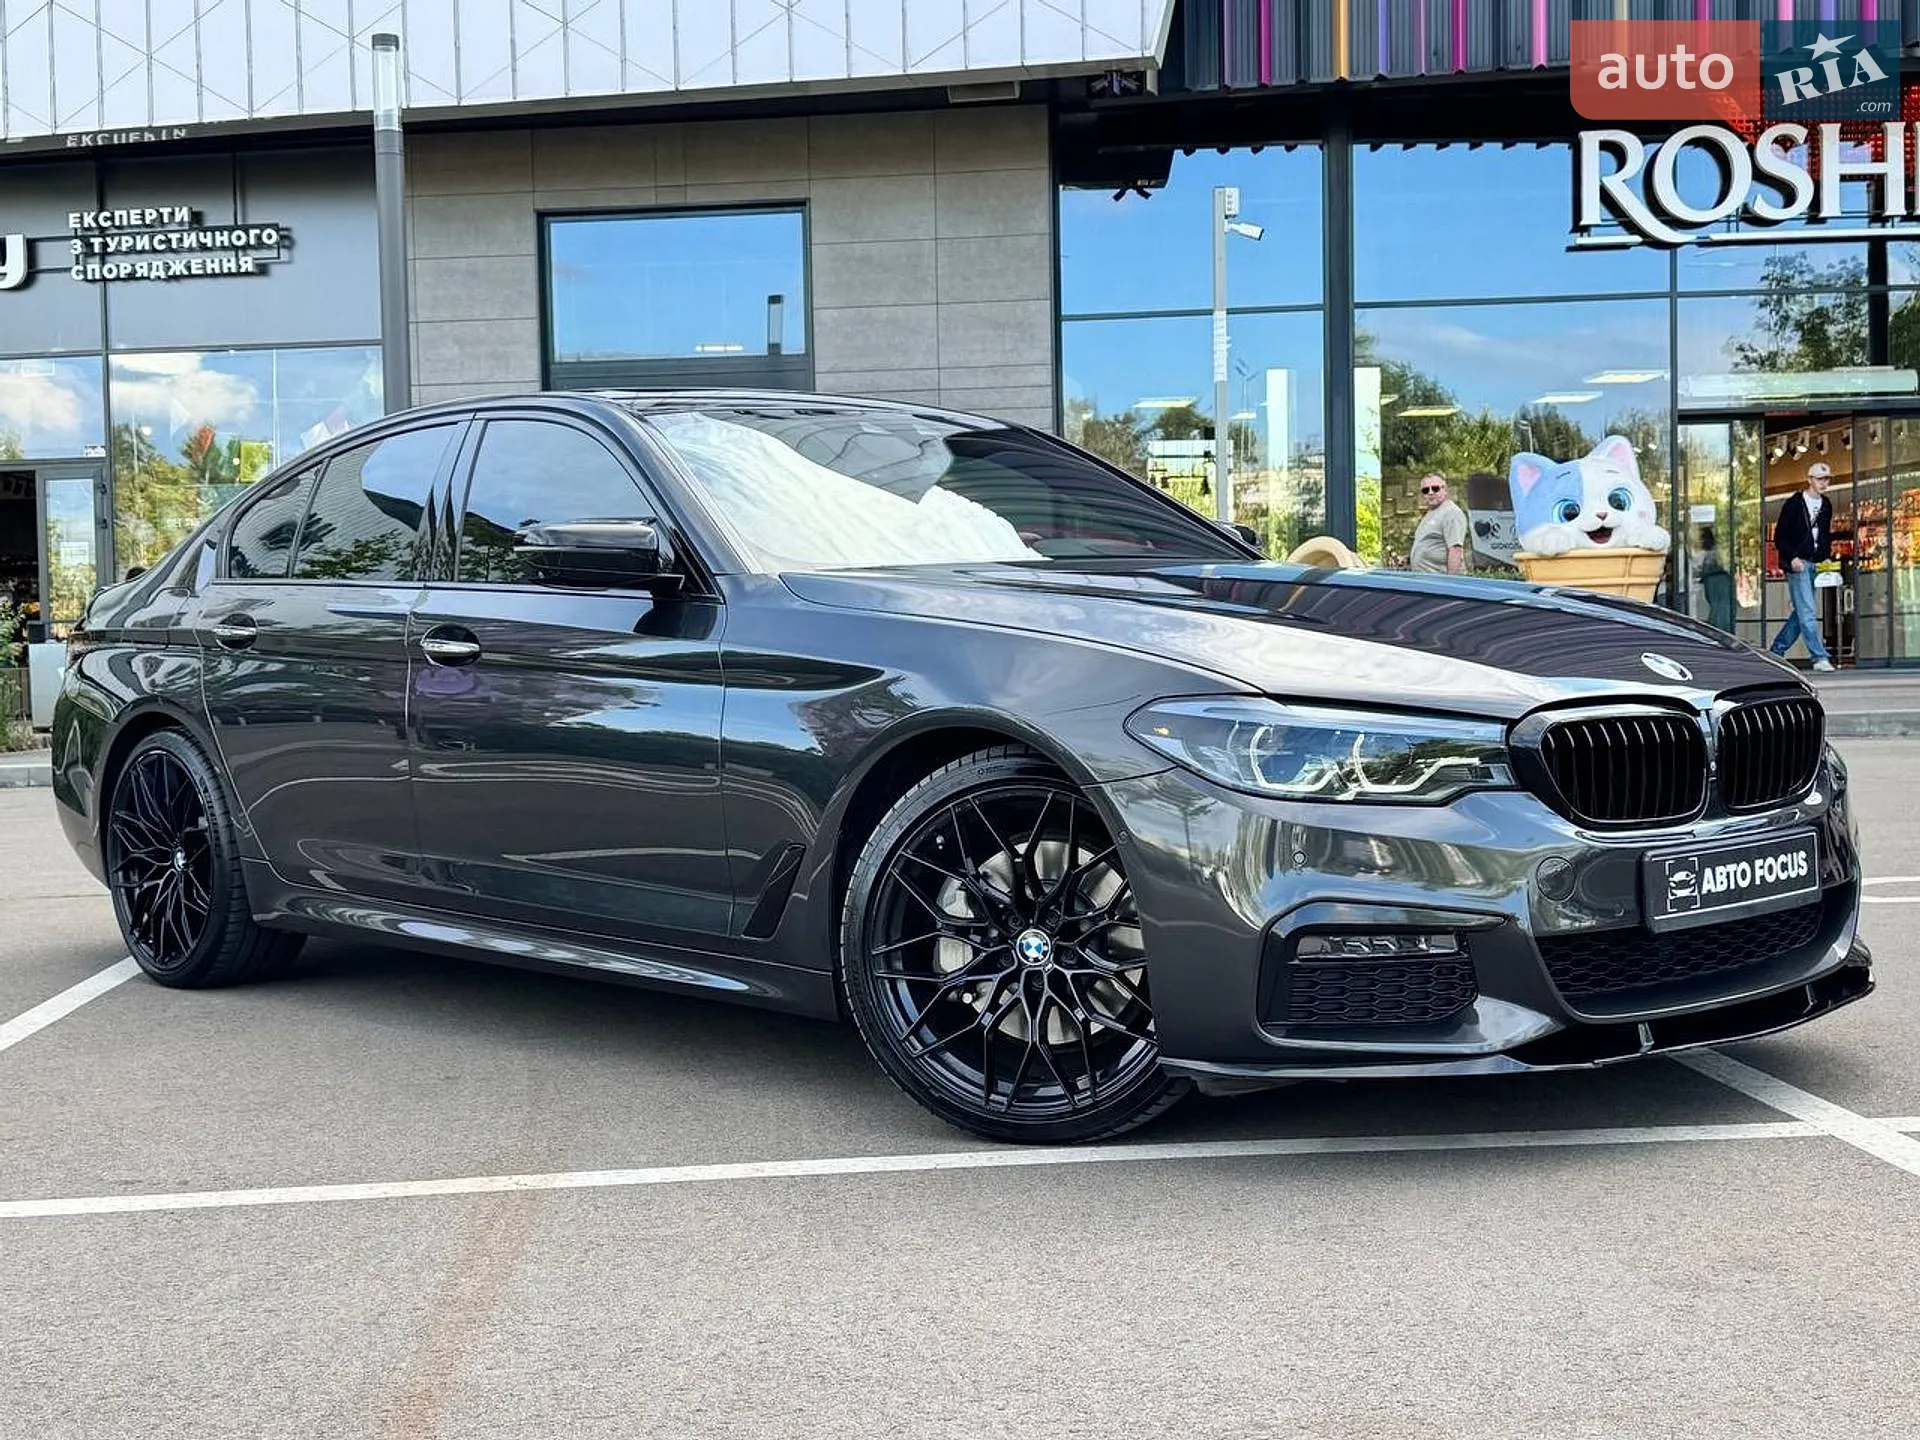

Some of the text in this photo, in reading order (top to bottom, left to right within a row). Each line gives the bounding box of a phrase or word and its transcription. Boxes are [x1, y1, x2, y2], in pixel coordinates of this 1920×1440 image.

[1578, 121, 1920, 243] ROSH
[68, 206, 189, 228] ЕКСПЕРТИ
[70, 228, 279, 255] З ТУРИСТИЧНОГО
[71, 256, 254, 280] СПОРЯДЖЕННЯ
[1701, 850, 1809, 895] АВТО FOCUS
